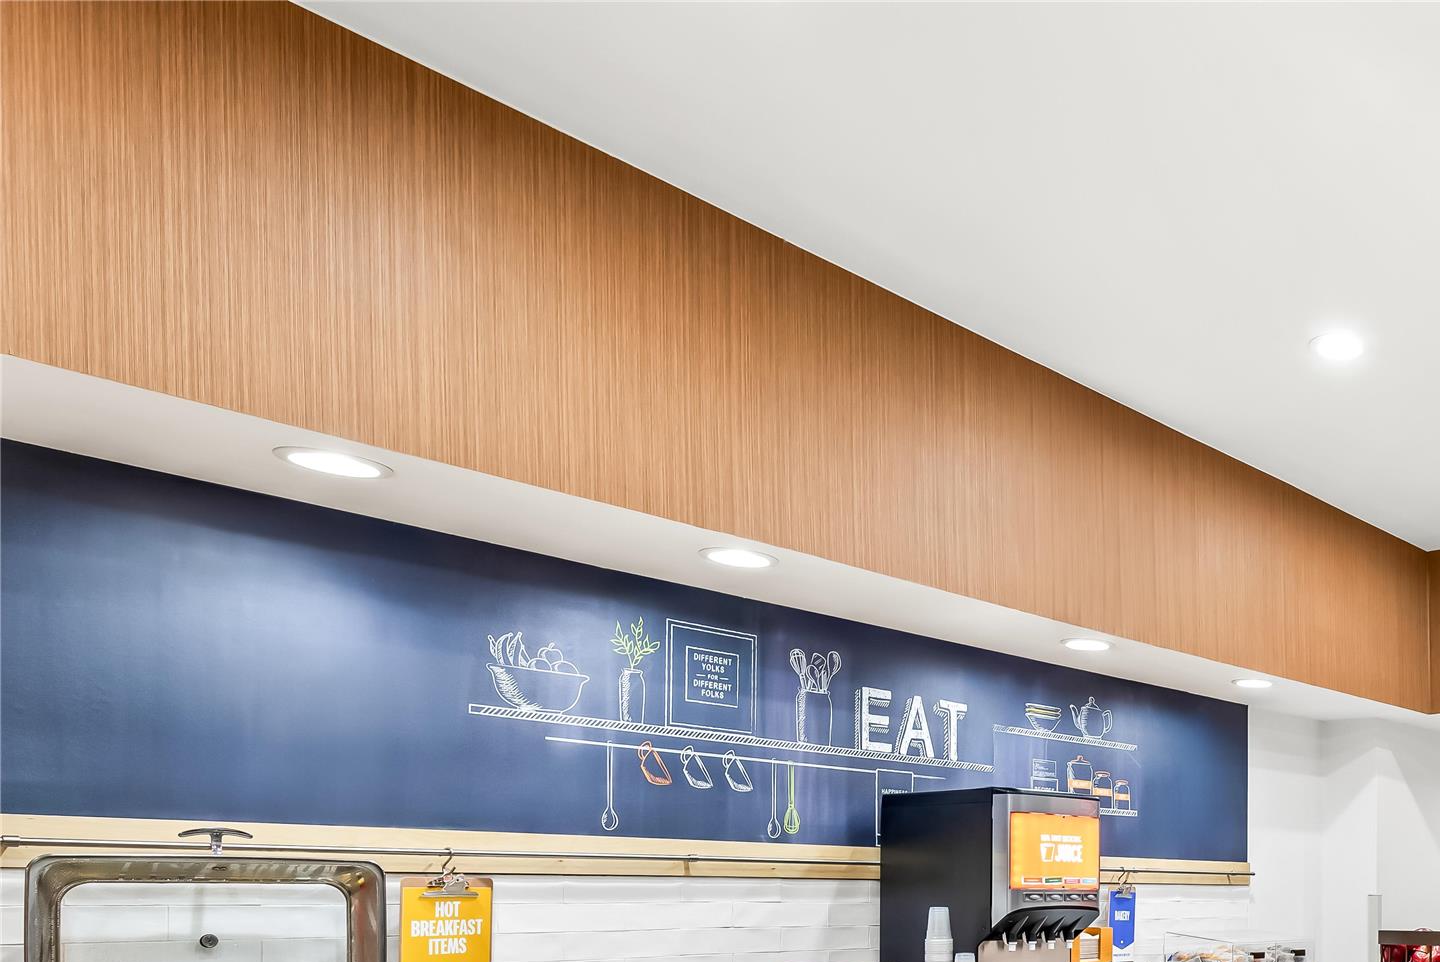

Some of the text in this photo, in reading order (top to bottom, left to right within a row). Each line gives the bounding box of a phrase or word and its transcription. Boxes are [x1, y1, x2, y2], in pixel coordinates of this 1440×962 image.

[694, 653, 732, 666] DIFFERENT
[702, 663, 724, 673] YOLKS
[693, 679, 732, 691] DIFFERENT
[702, 689, 724, 699] FOLKS
[855, 686, 967, 761] EAT
[435, 901, 461, 918] HOT
[411, 919, 483, 937] BREAKFAST
[428, 937, 467, 955] ITEMS
